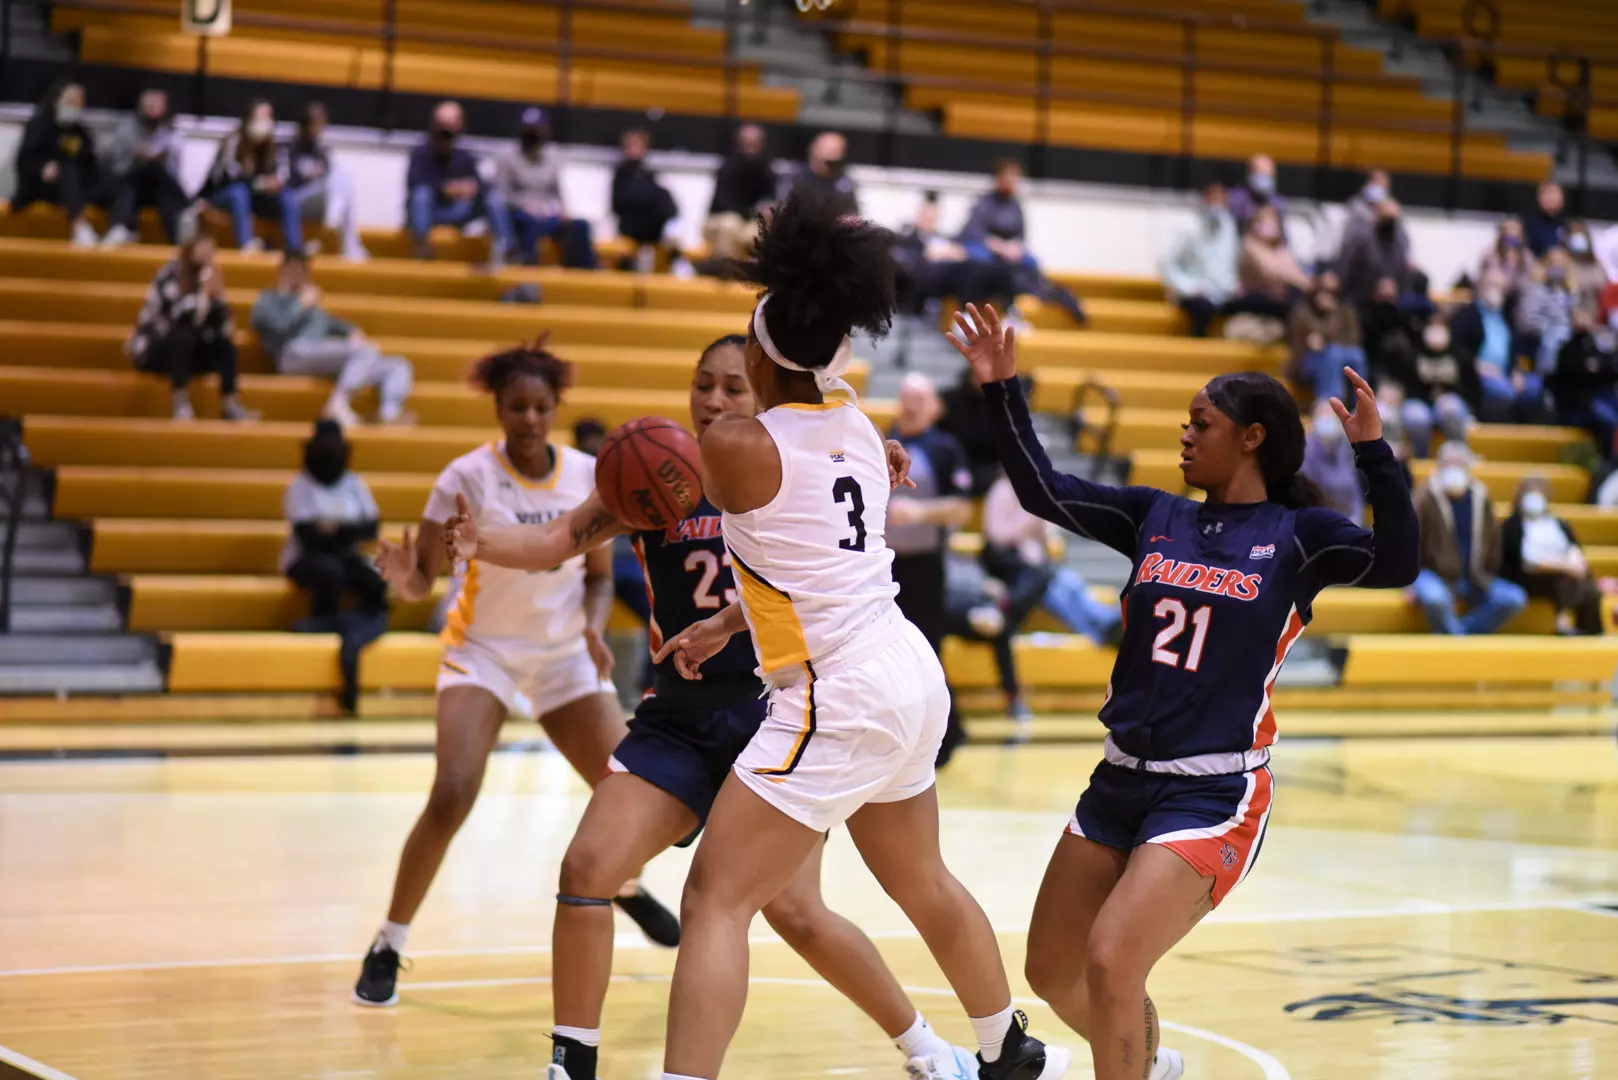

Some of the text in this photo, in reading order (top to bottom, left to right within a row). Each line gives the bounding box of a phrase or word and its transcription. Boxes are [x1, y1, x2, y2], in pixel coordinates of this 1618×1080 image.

[832, 476, 867, 552] 3
[1134, 552, 1262, 601] RAIDERS
[1151, 597, 1213, 672] 21
